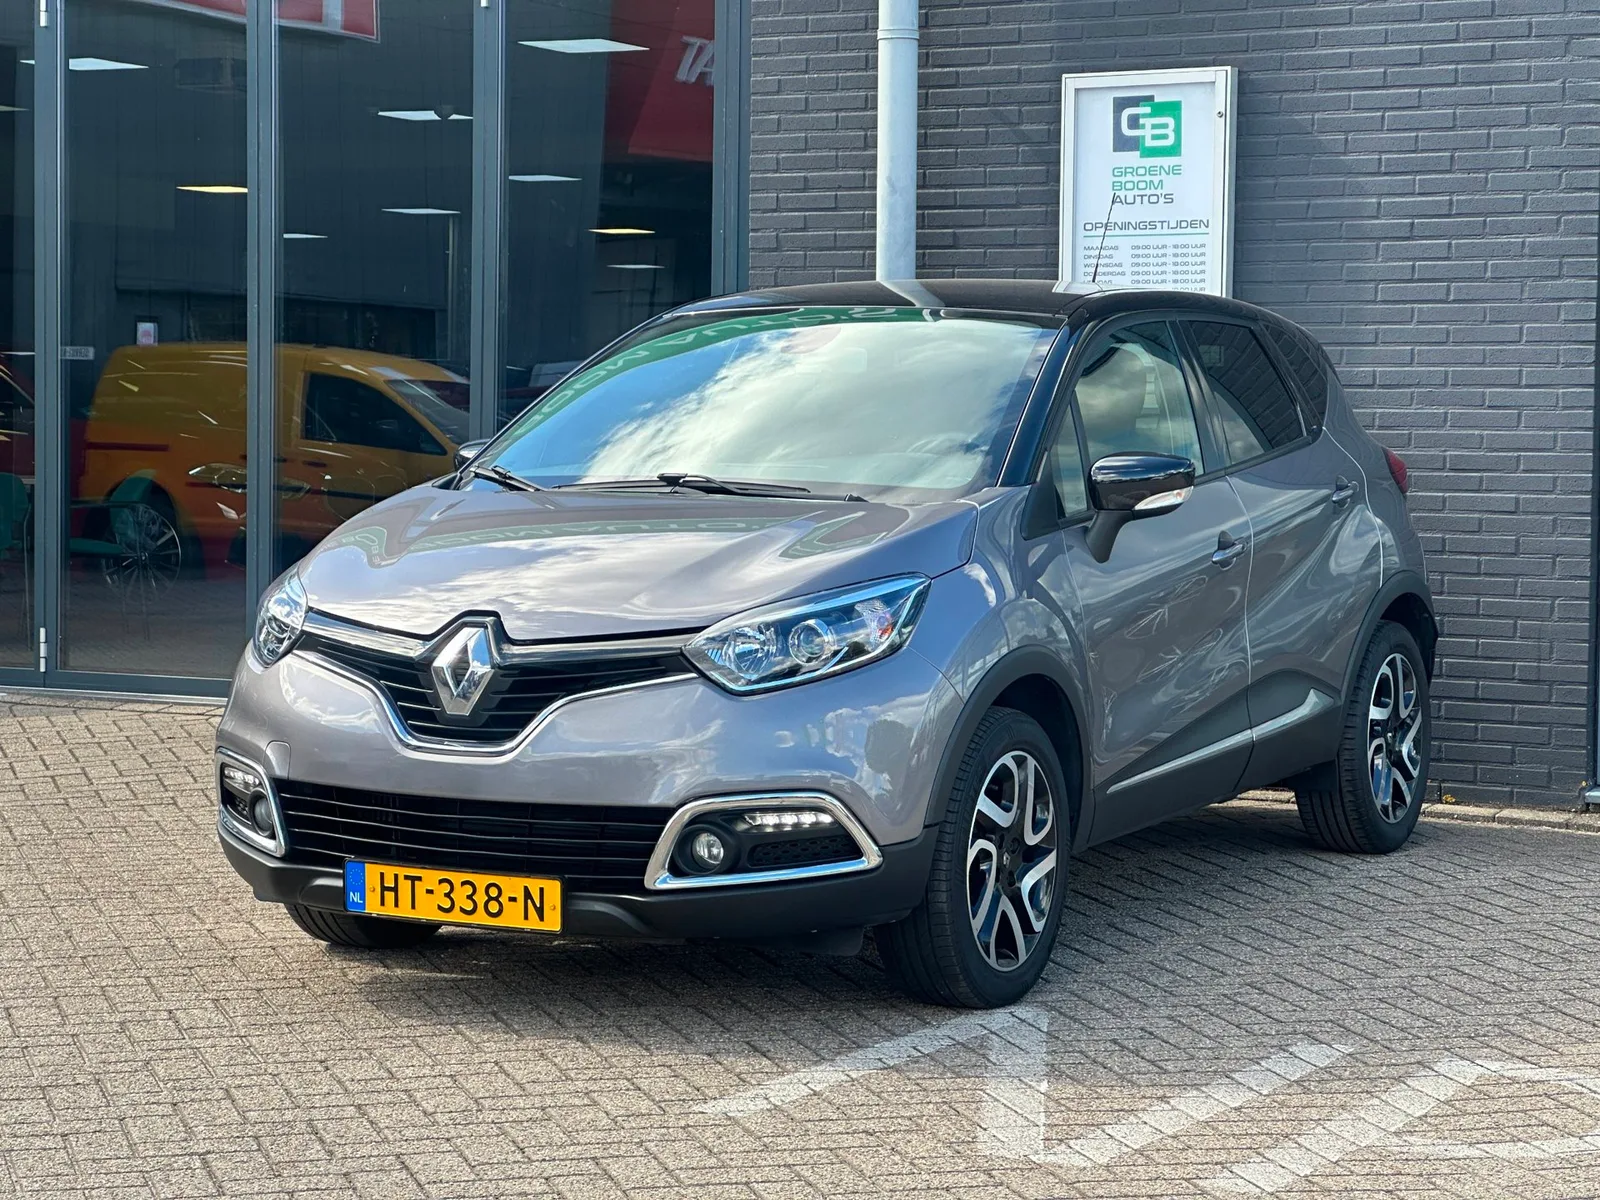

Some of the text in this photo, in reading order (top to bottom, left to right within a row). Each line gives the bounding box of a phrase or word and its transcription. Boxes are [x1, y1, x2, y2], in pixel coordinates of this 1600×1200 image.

[1112, 164, 1182, 177] GROENE
[1112, 179, 1163, 191] BOOM
[1112, 193, 1174, 206] AUTO'S
[1083, 219, 1210, 232] OPENINGSTIJDEN
[350, 891, 363, 904] NL
[379, 871, 545, 922] HT-338-N
